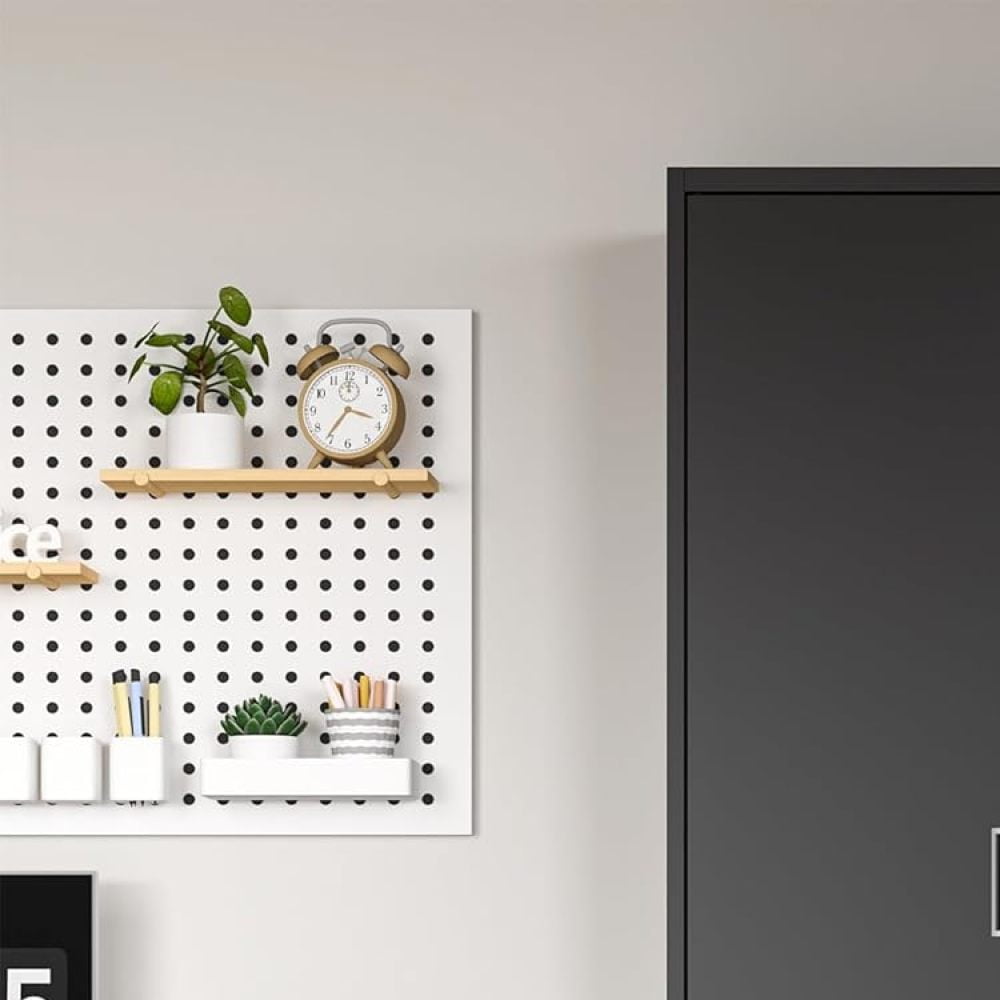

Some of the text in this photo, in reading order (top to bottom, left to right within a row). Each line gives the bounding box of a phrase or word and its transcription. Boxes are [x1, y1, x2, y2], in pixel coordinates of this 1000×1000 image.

[330, 375, 338, 386] 11
[344, 371, 356, 380] 12
[364, 375, 369, 385] 1
[316, 389, 326, 399] 10
[376, 387, 383, 397] 2
[310, 406, 317, 416] 9
[381, 404, 388, 414] 3
[315, 423, 321, 433] 8
[375, 421, 381, 431] 4
[364, 433, 371, 444] 5
[344, 439, 352, 449] 6
